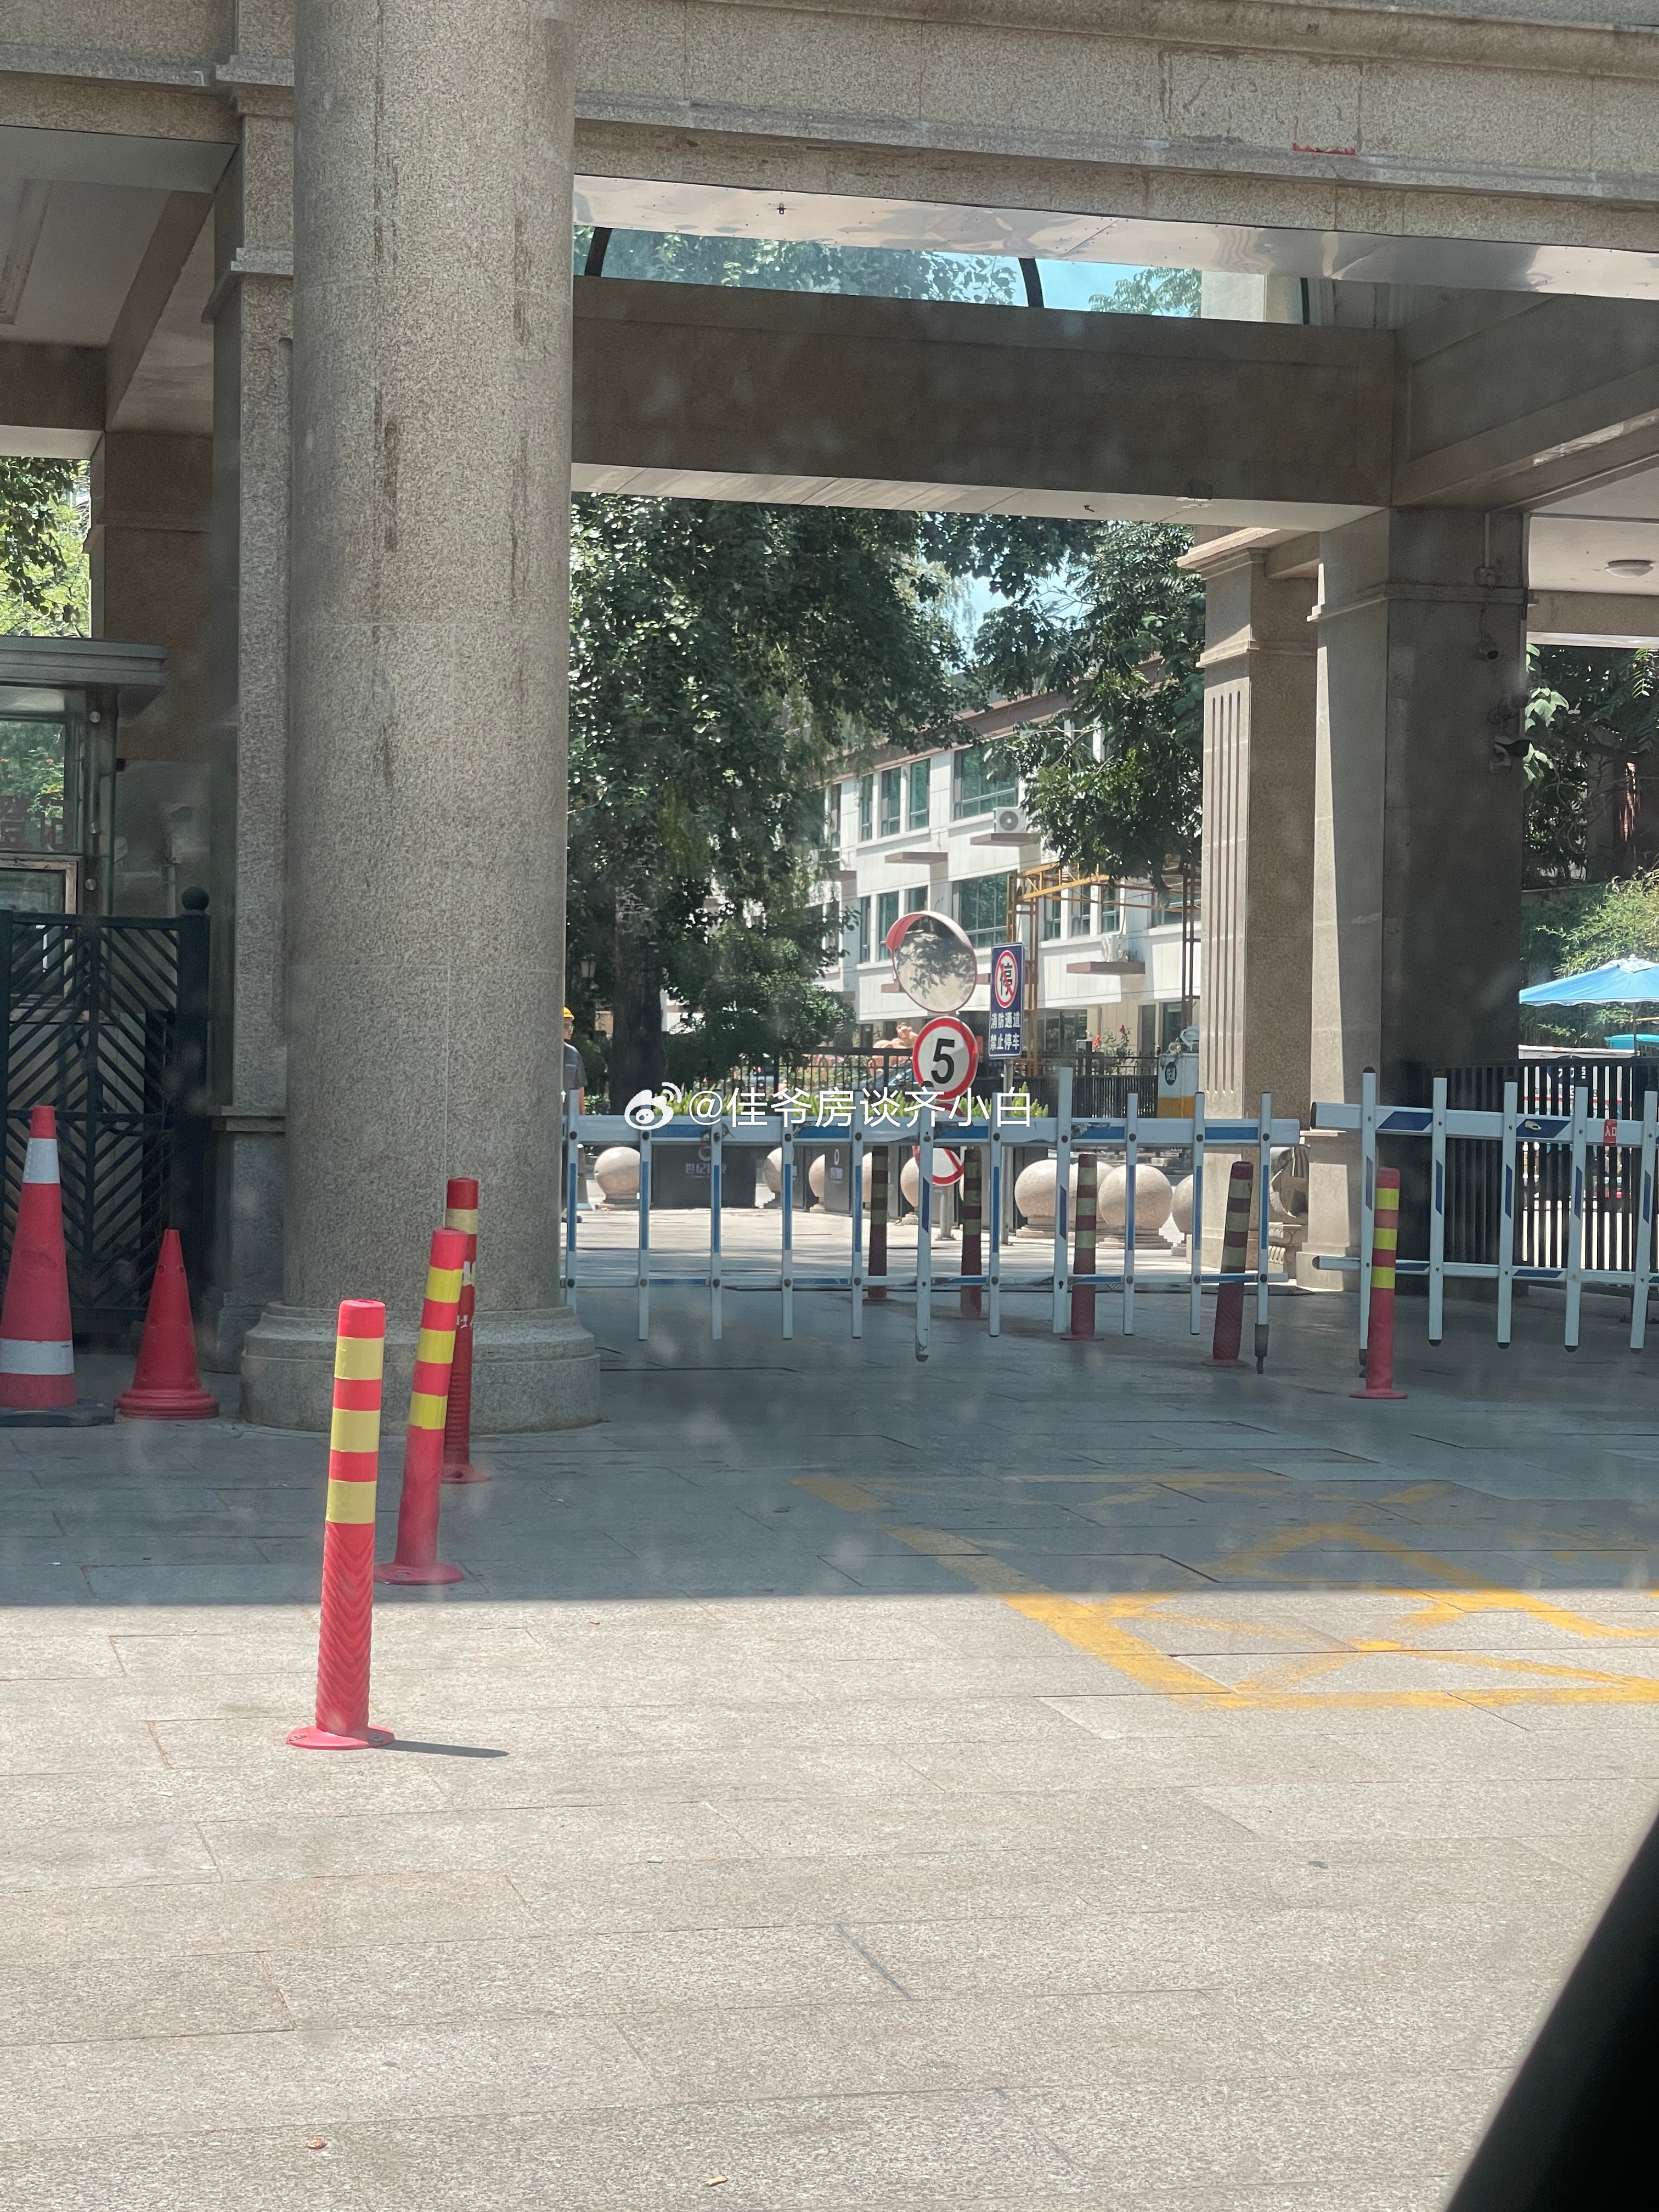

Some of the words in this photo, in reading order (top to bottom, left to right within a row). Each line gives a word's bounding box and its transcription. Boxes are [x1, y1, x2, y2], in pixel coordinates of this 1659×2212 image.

[991, 1012, 1020, 1029] 消防通道
[990, 1033, 1020, 1051] 禁止停车
[931, 1038, 955, 1084] 5
[1605, 1126, 1617, 1137] 入口
